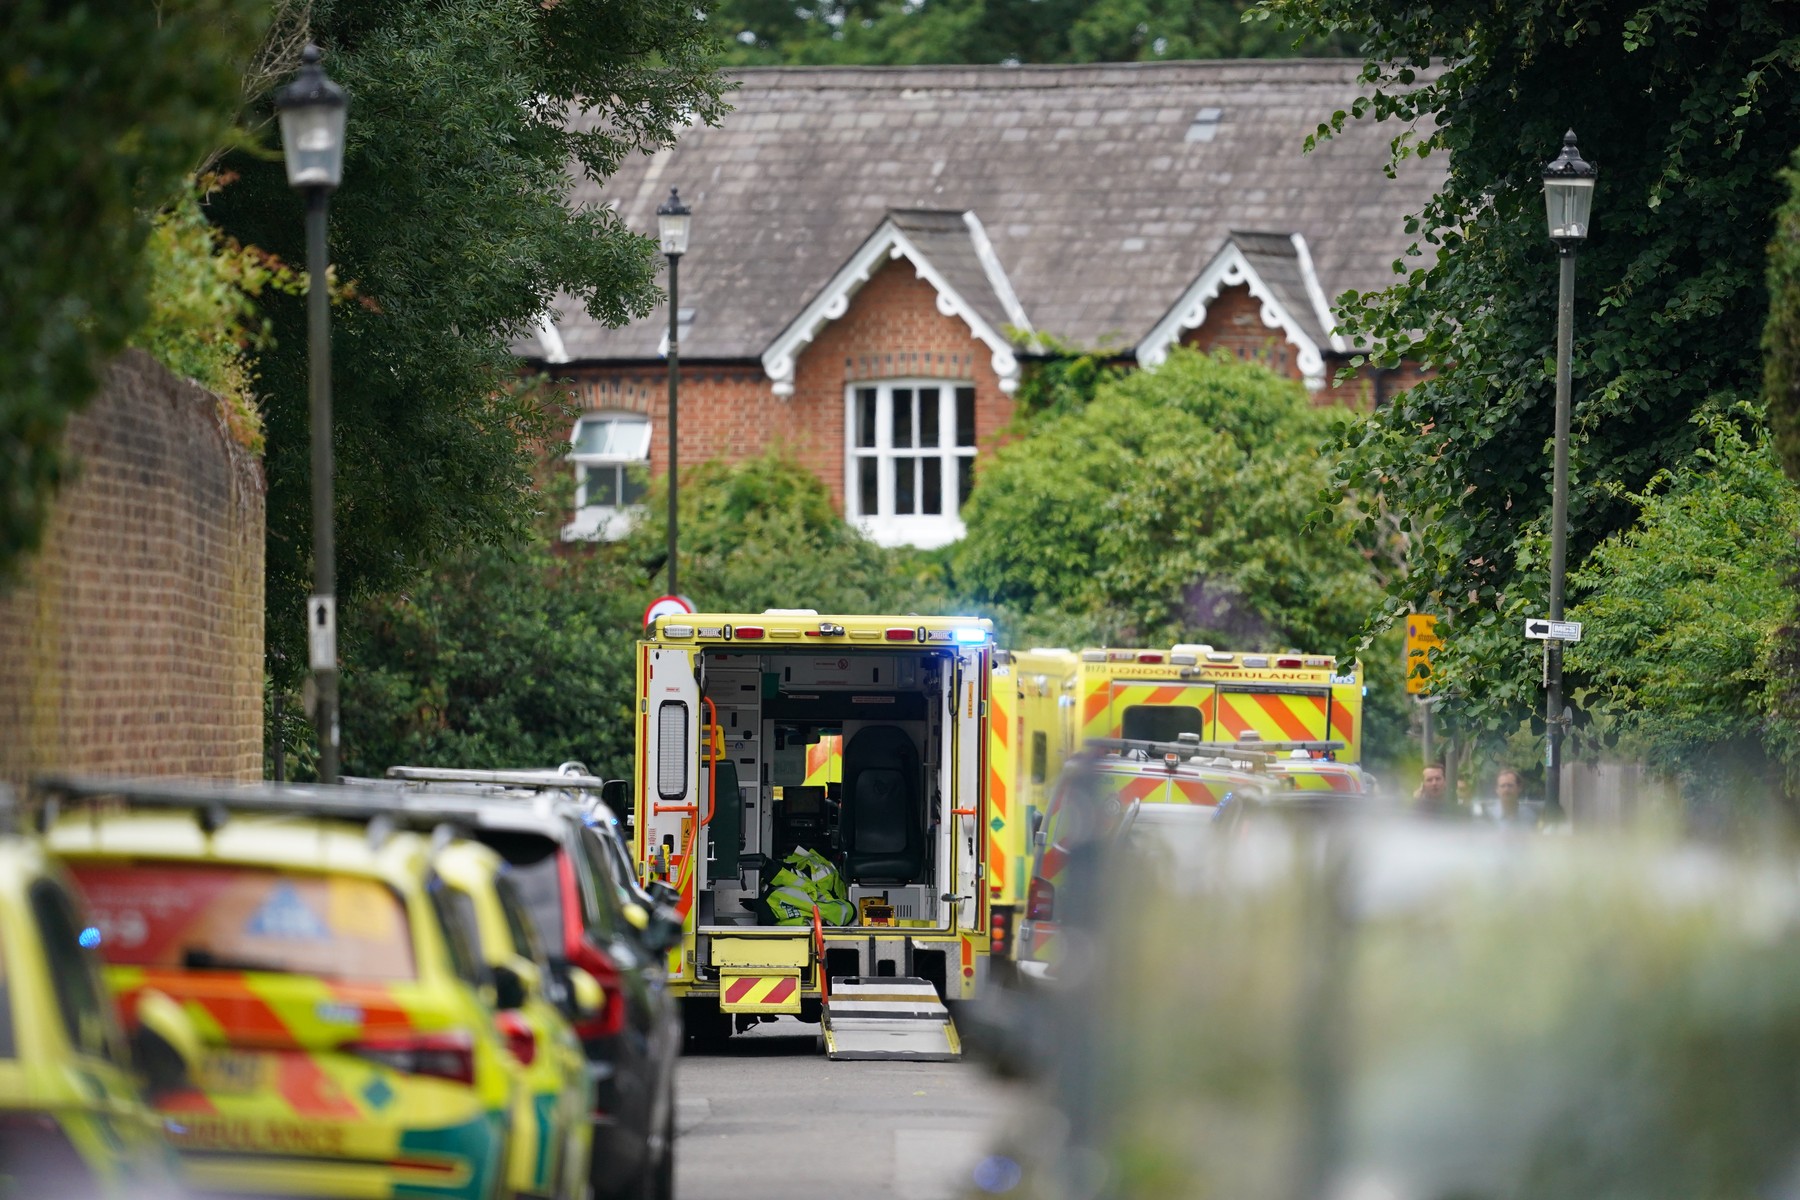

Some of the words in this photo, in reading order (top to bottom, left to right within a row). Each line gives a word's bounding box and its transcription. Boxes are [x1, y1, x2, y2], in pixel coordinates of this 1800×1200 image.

[1110, 667, 1179, 677] LONDON
[1200, 670, 1321, 680] AMBULANCE
[1331, 674, 1355, 684] NHS
